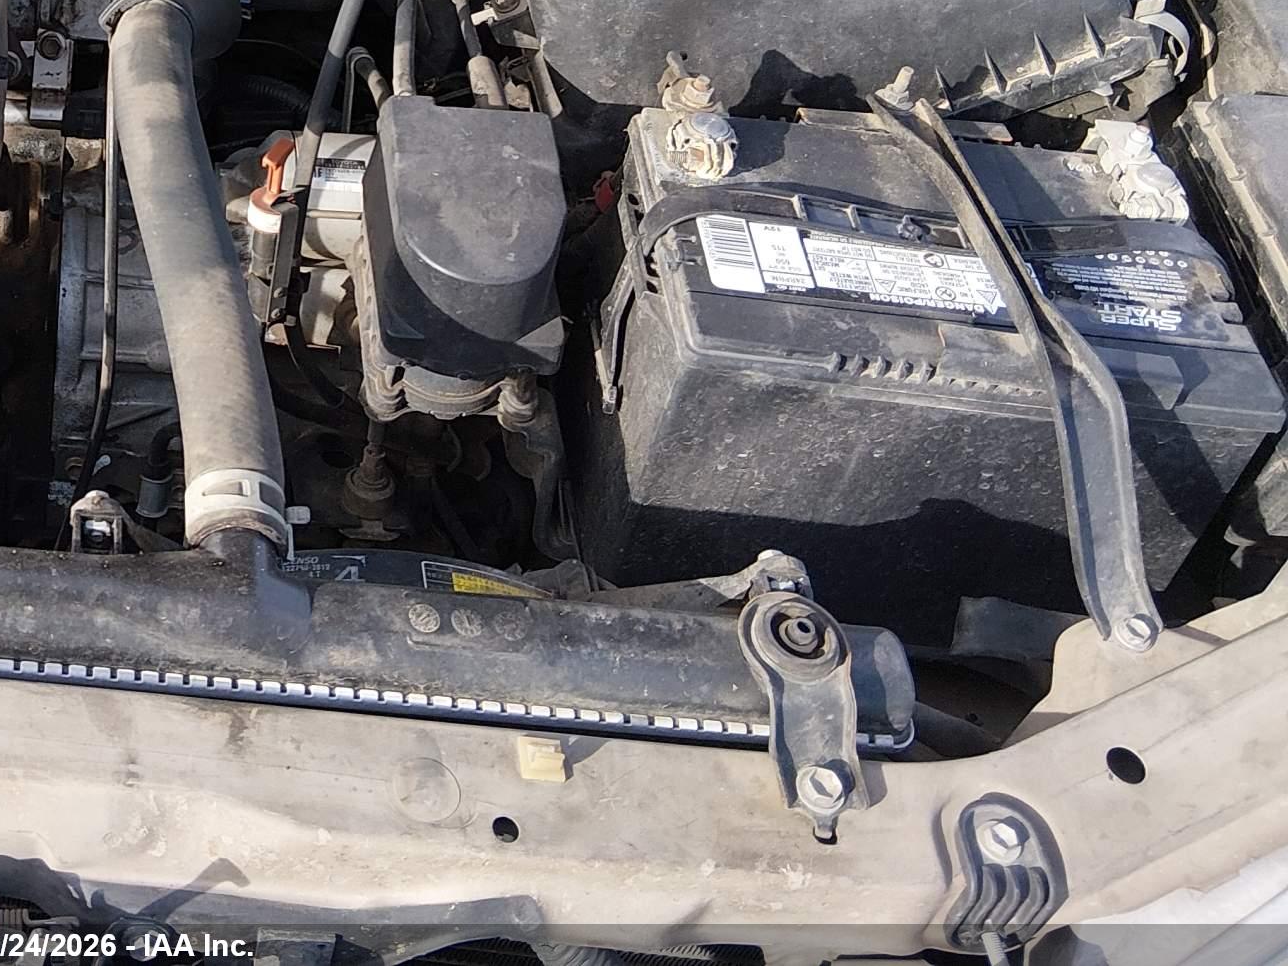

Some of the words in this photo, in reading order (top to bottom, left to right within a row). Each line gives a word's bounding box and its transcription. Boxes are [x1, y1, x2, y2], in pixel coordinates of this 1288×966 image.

[869, 293, 985, 314] DANGER/POISON
[1097, 303, 1182, 324] START
[1100, 314, 1177, 332] SUPER
